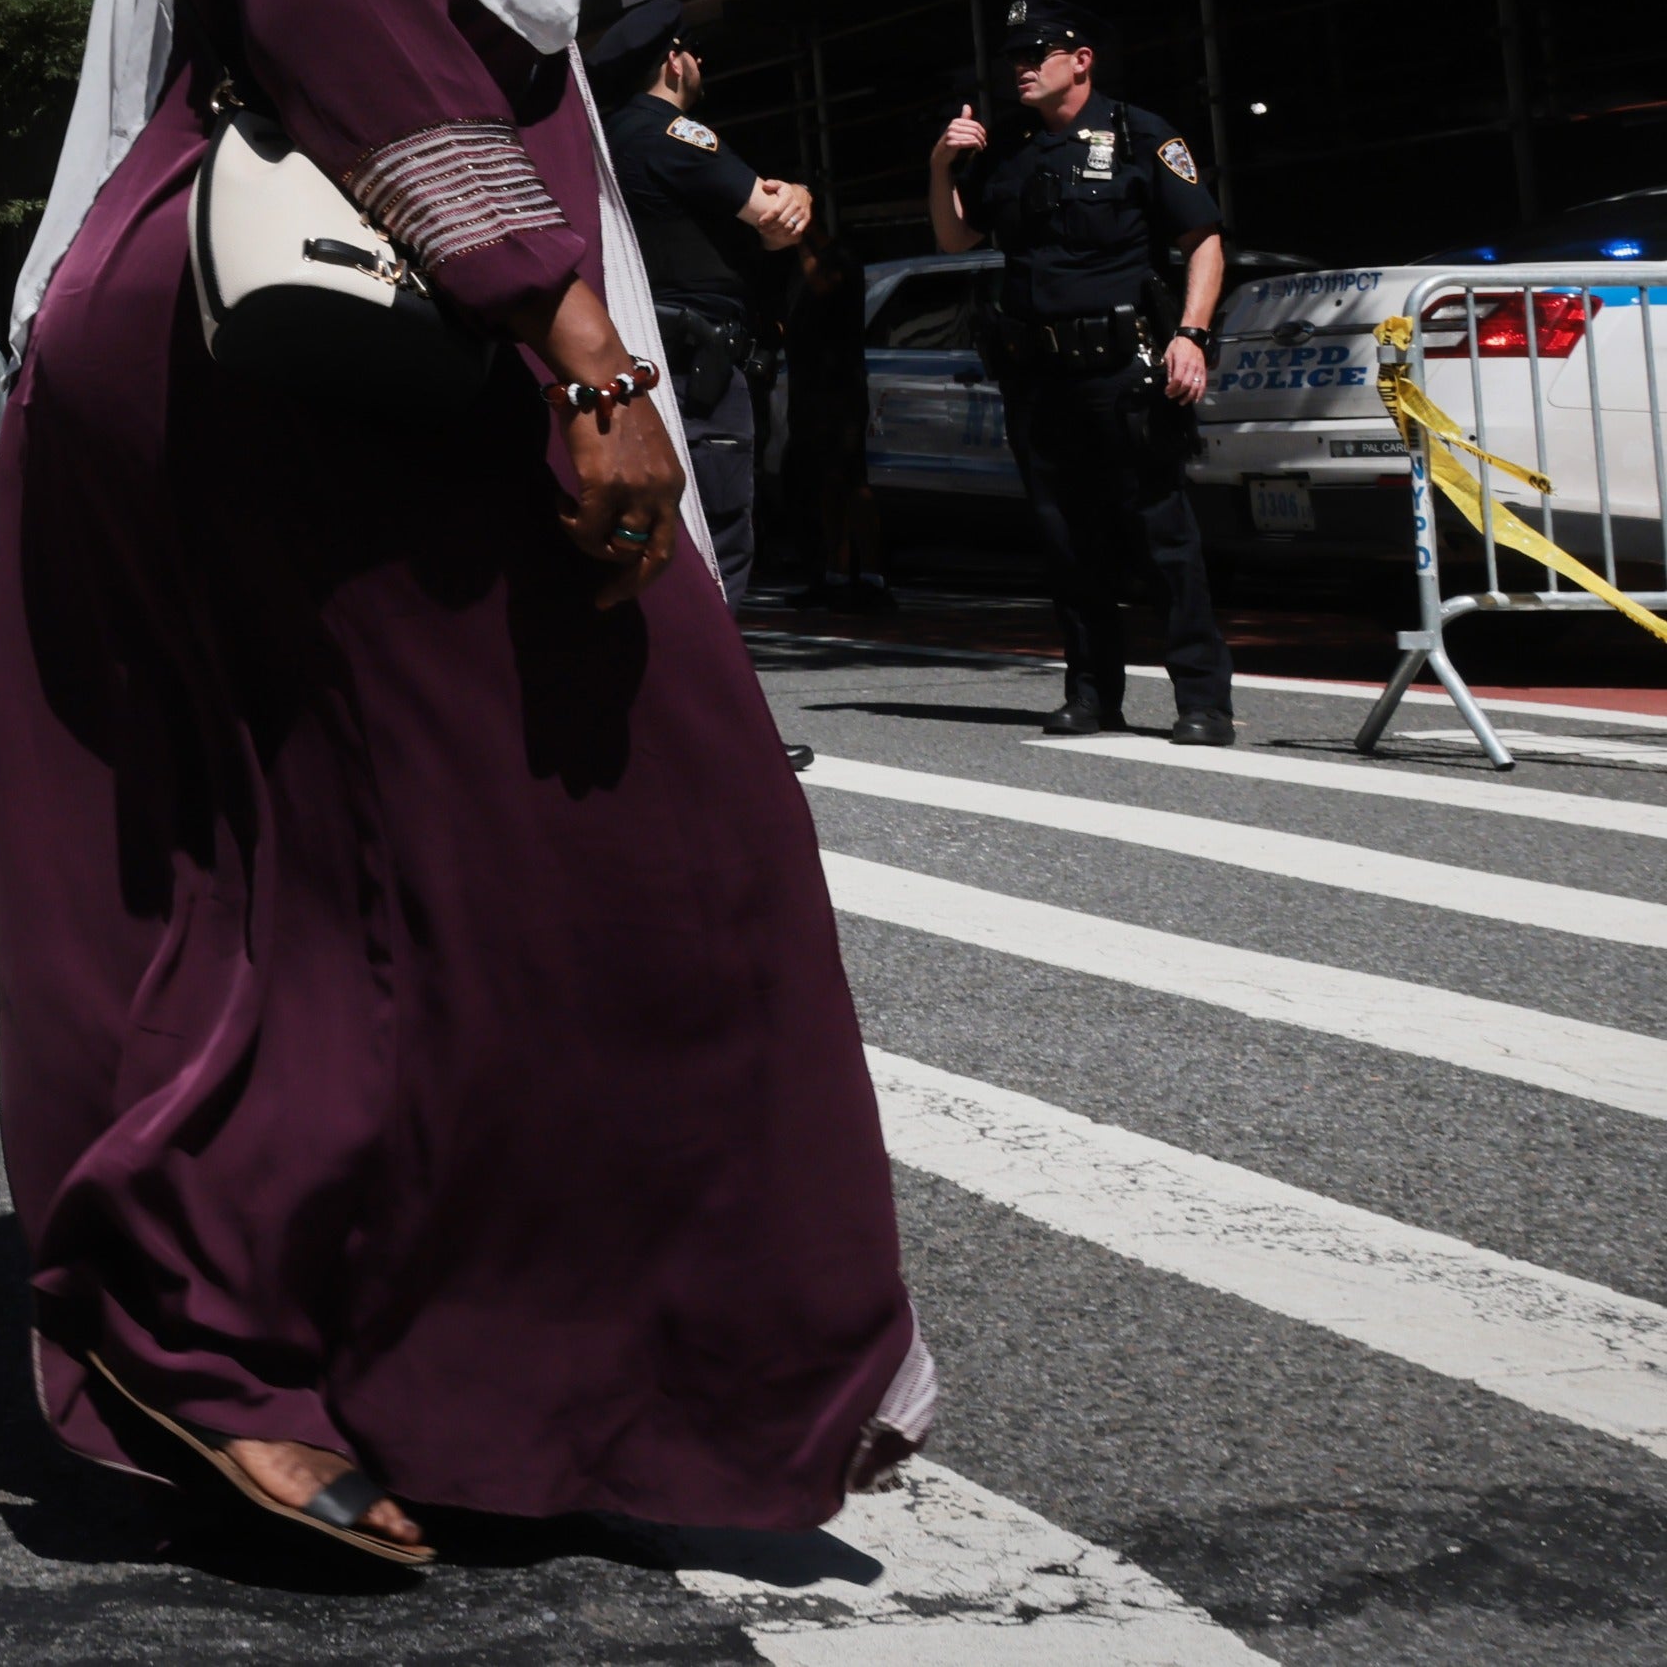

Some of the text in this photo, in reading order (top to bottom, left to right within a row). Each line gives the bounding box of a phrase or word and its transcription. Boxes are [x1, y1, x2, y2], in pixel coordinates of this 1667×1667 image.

[1238, 346, 1351, 370] NYPD
[1218, 366, 1368, 391] POLICE
[1362, 443, 1379, 452] PAL
[1410, 455, 1432, 572] NYPD
